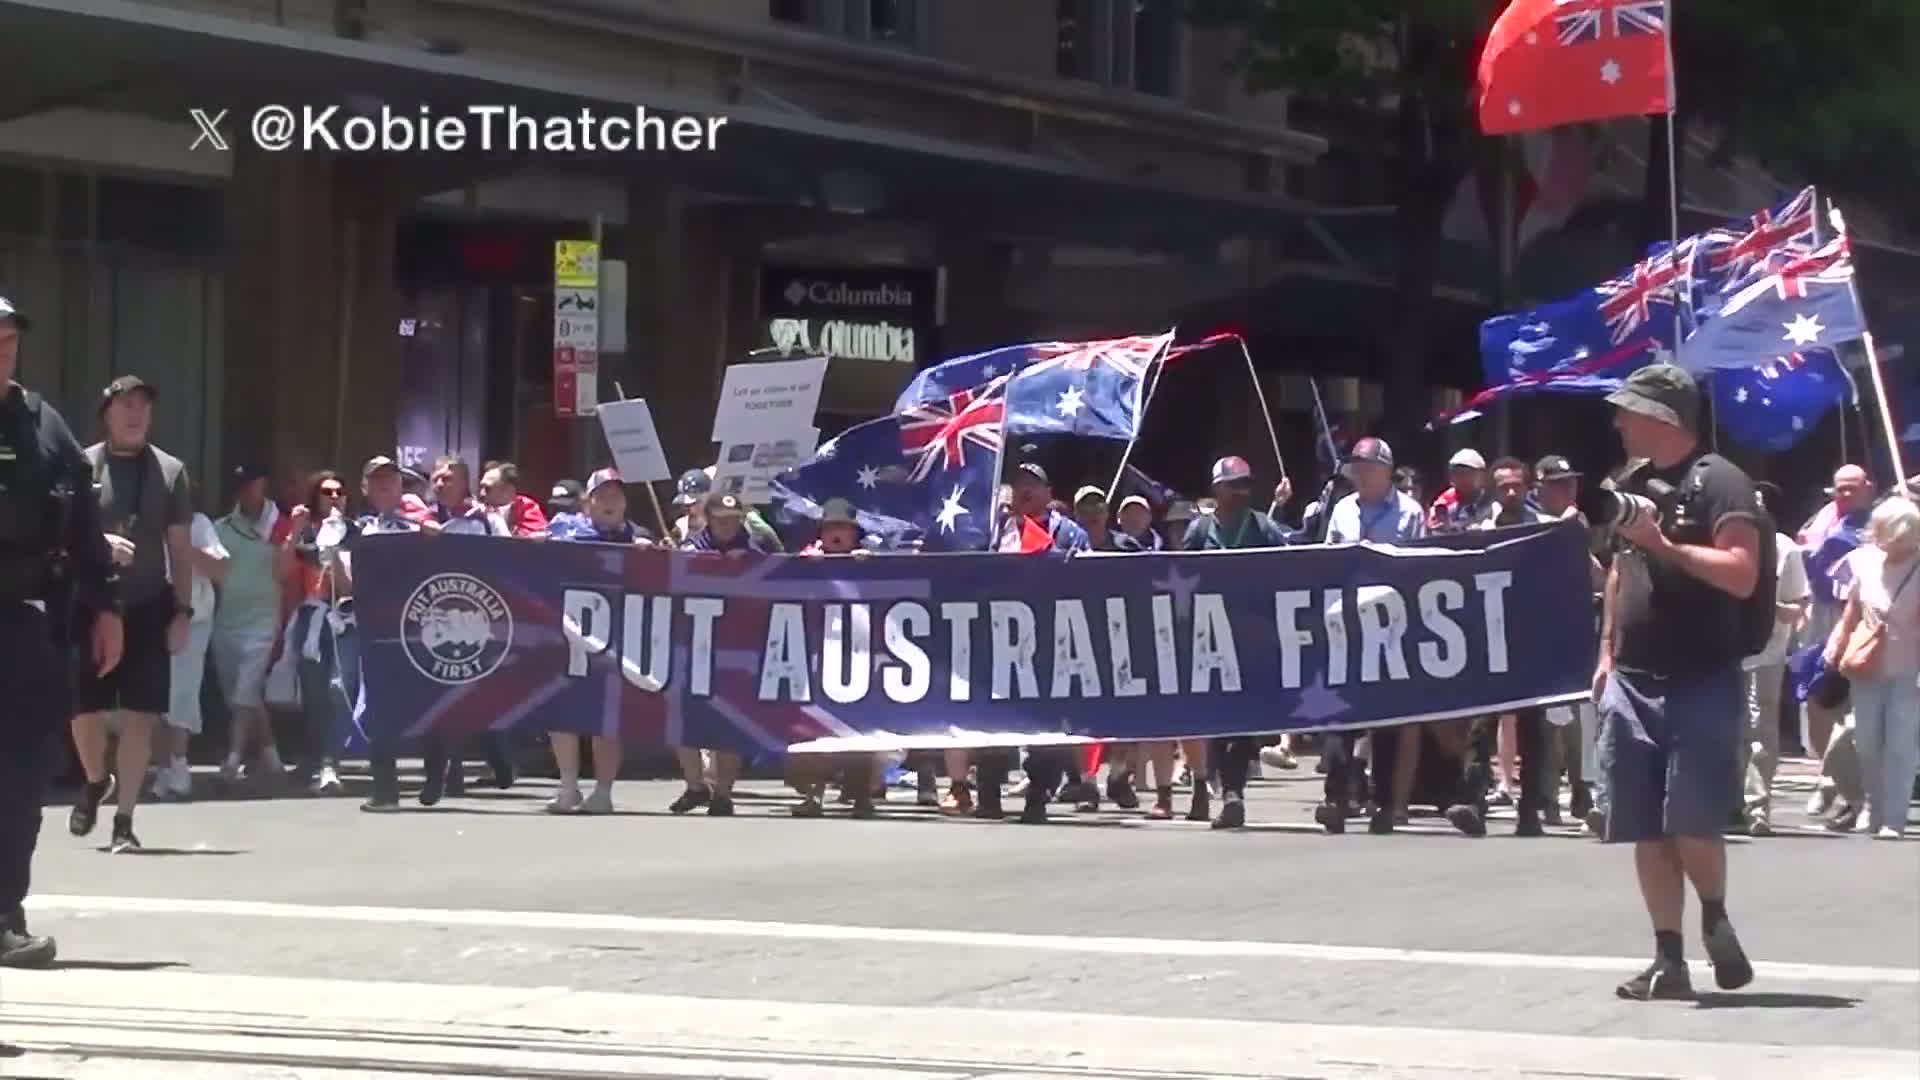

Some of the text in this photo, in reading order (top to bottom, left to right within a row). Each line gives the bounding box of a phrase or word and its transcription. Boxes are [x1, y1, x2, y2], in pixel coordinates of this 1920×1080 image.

[808, 280, 913, 305] Columbia
[407, 579, 505, 622] PUT AUSTRALIA
[562, 570, 1513, 704] PUT AUSTRALIA FIRST
[432, 658, 482, 678] FIRST
